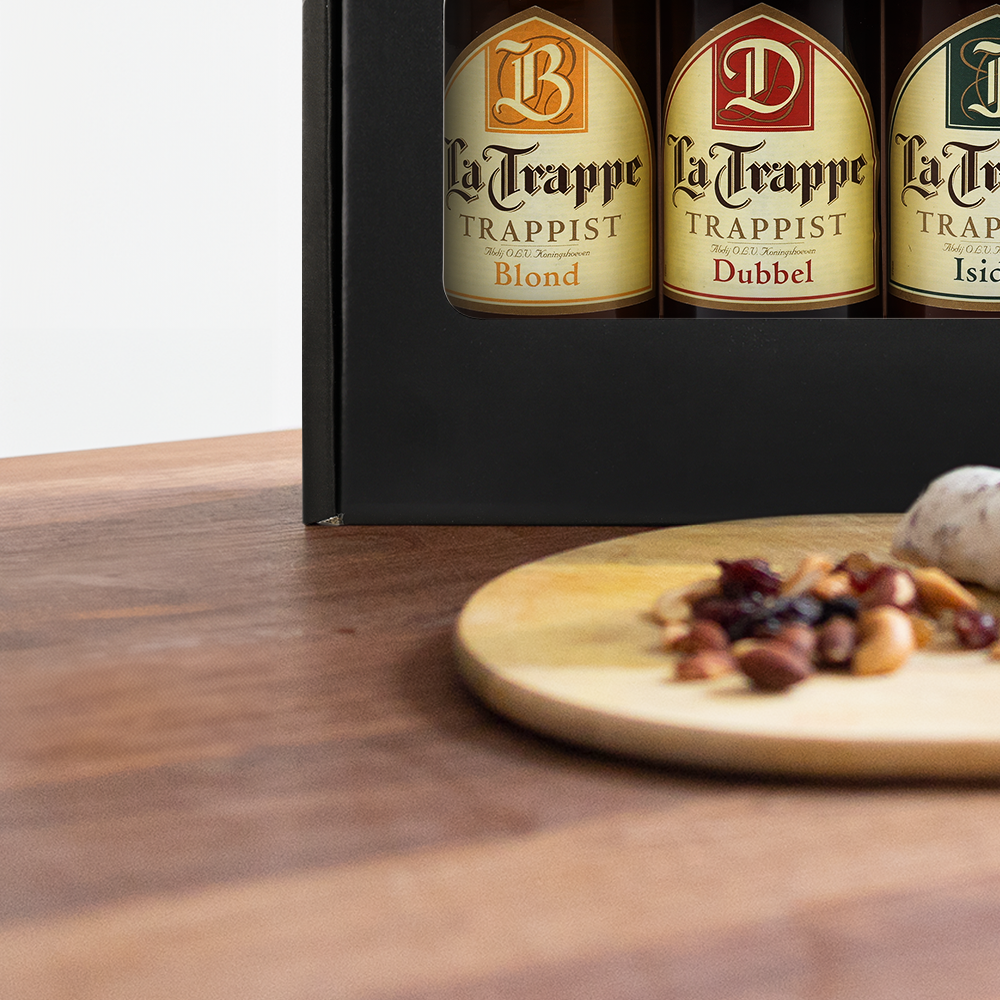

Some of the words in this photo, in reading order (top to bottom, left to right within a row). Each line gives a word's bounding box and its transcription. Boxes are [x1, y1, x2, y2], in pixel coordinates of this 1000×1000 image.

[495, 38, 572, 122] B
[723, 37, 801, 115] D
[445, 137, 486, 210] La
[482, 142, 643, 213] Trappe
[667, 134, 712, 208] La
[708, 139, 868, 210] Trappe
[895, 133, 945, 207] La
[459, 213, 622, 242] TRAPPIST
[685, 211, 847, 240] TRAPPIST
[494, 260, 581, 288] Blond
[713, 258, 815, 285] Dubbel
